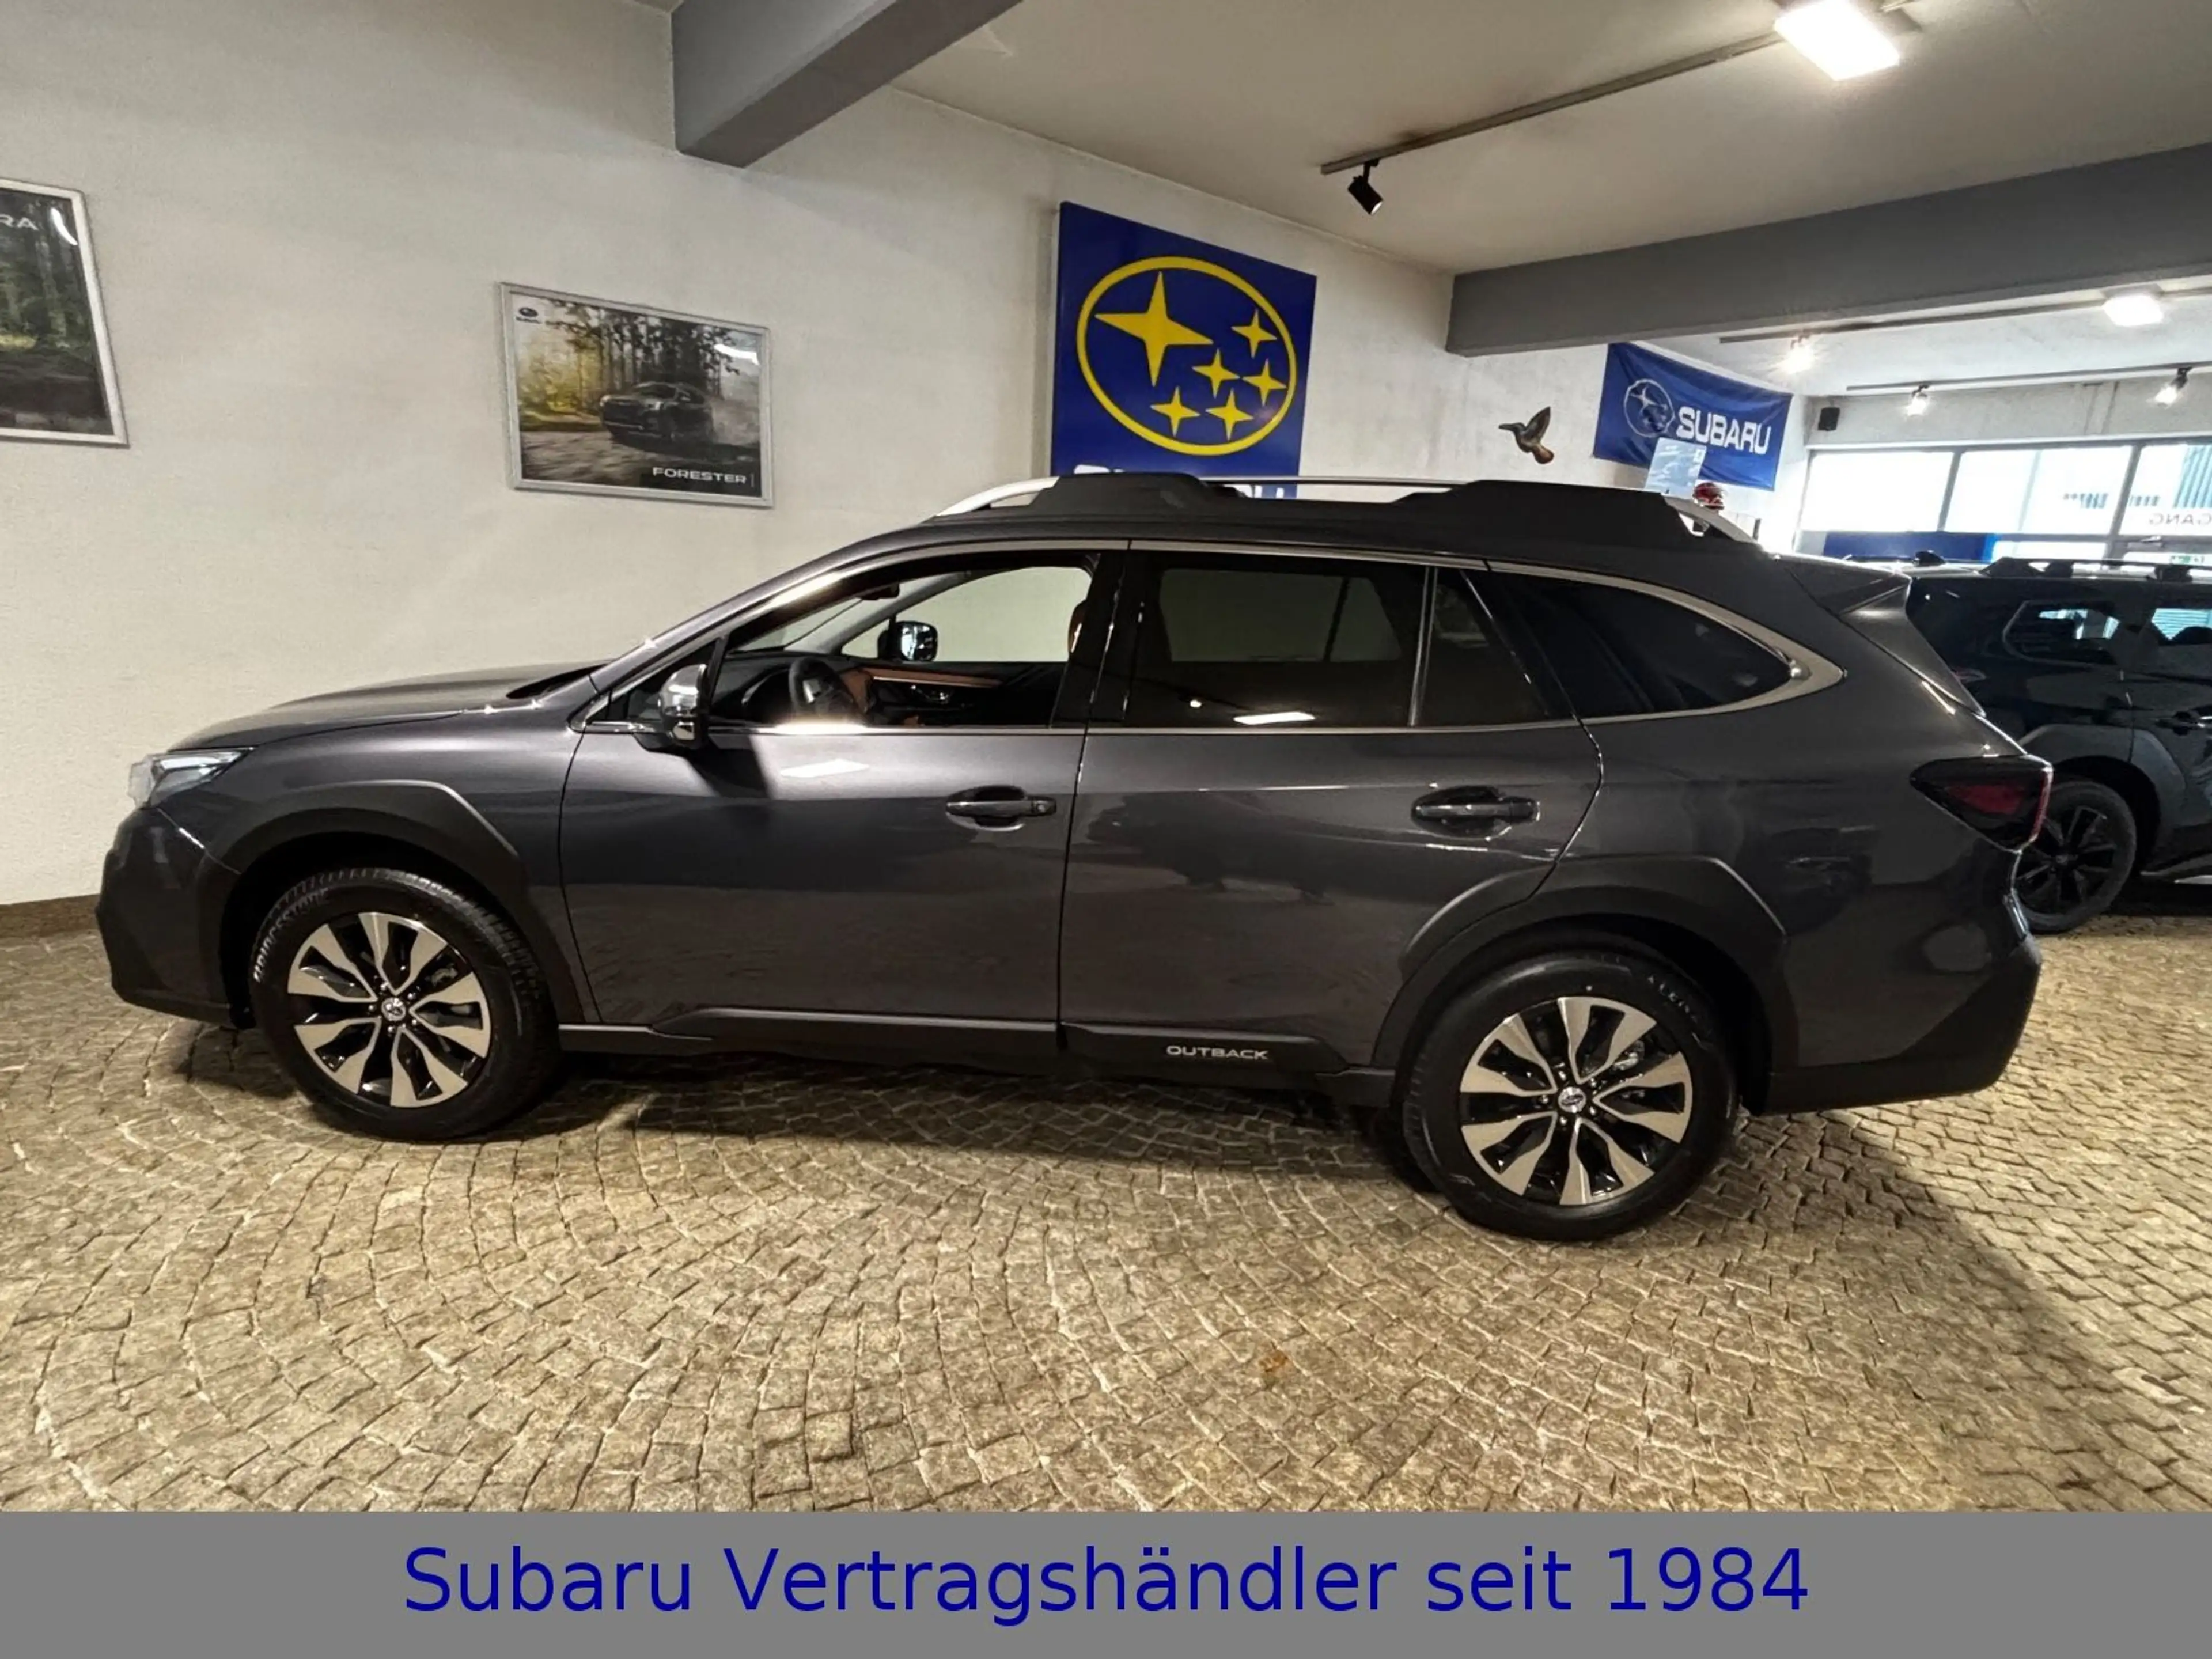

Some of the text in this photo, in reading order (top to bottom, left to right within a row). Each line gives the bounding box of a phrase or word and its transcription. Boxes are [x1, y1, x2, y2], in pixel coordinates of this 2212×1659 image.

[1676, 406, 1771, 454] SUBARU
[652, 467, 747, 484] FORESTER
[1166, 1045, 1268, 1060] OUTBACK
